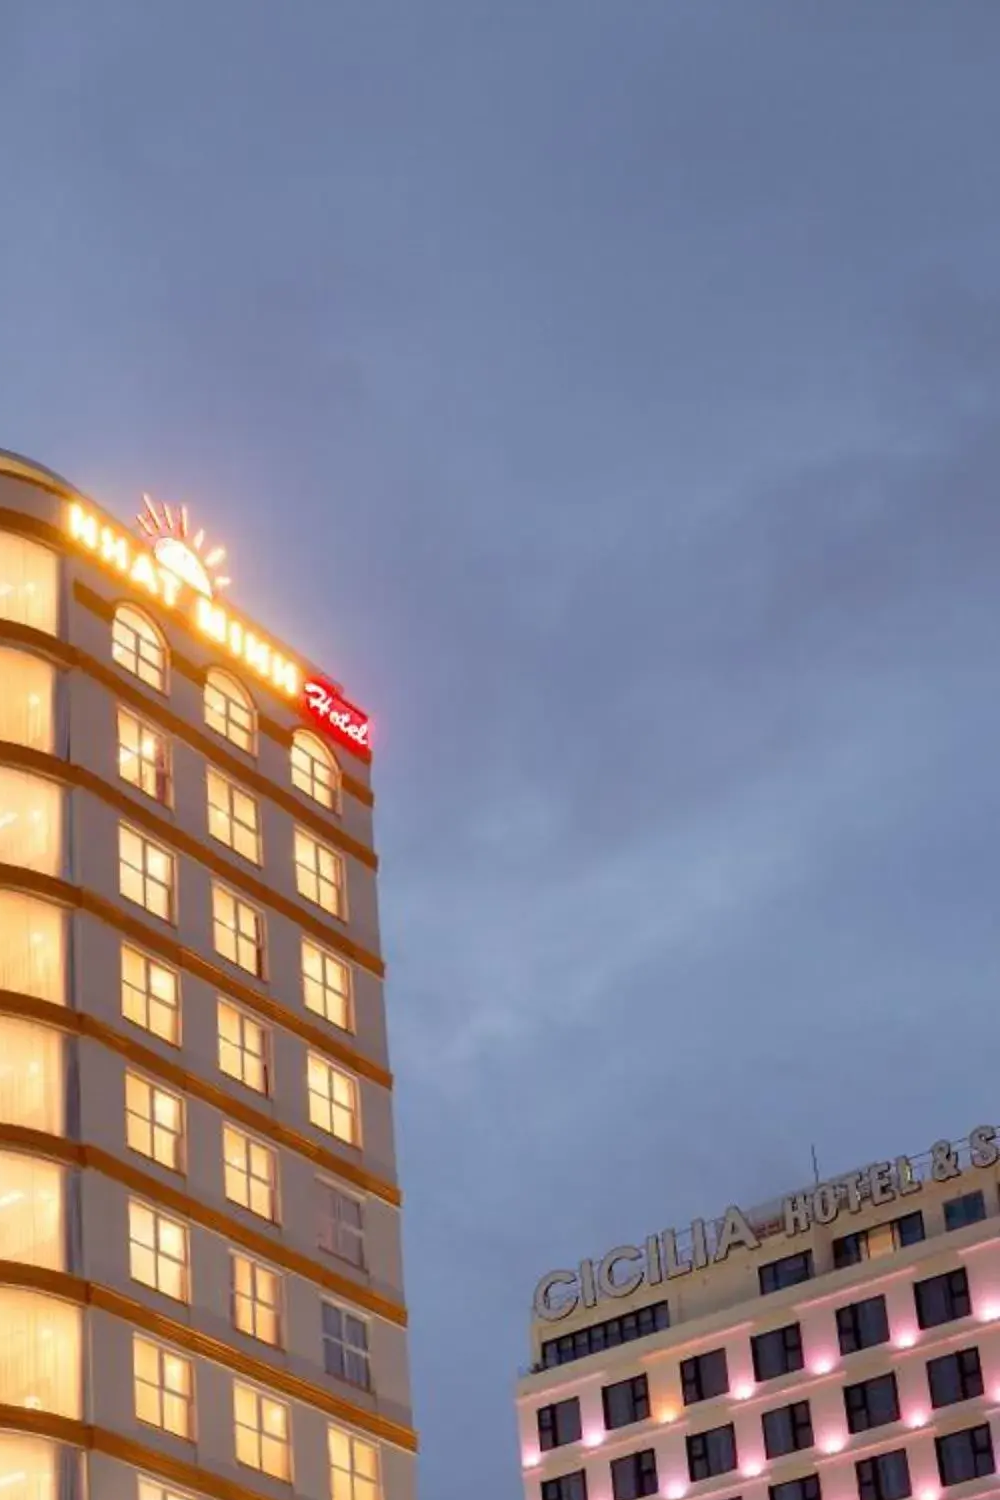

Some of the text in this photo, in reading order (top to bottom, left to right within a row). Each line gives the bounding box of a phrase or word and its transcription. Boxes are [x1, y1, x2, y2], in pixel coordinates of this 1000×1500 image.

[196, 597, 298, 695] MINH
[304, 682, 368, 745] Hotel
[533, 1203, 762, 1322] CICILIA
[783, 1154, 923, 1238] HOTEL
[930, 1139, 962, 1183] &
